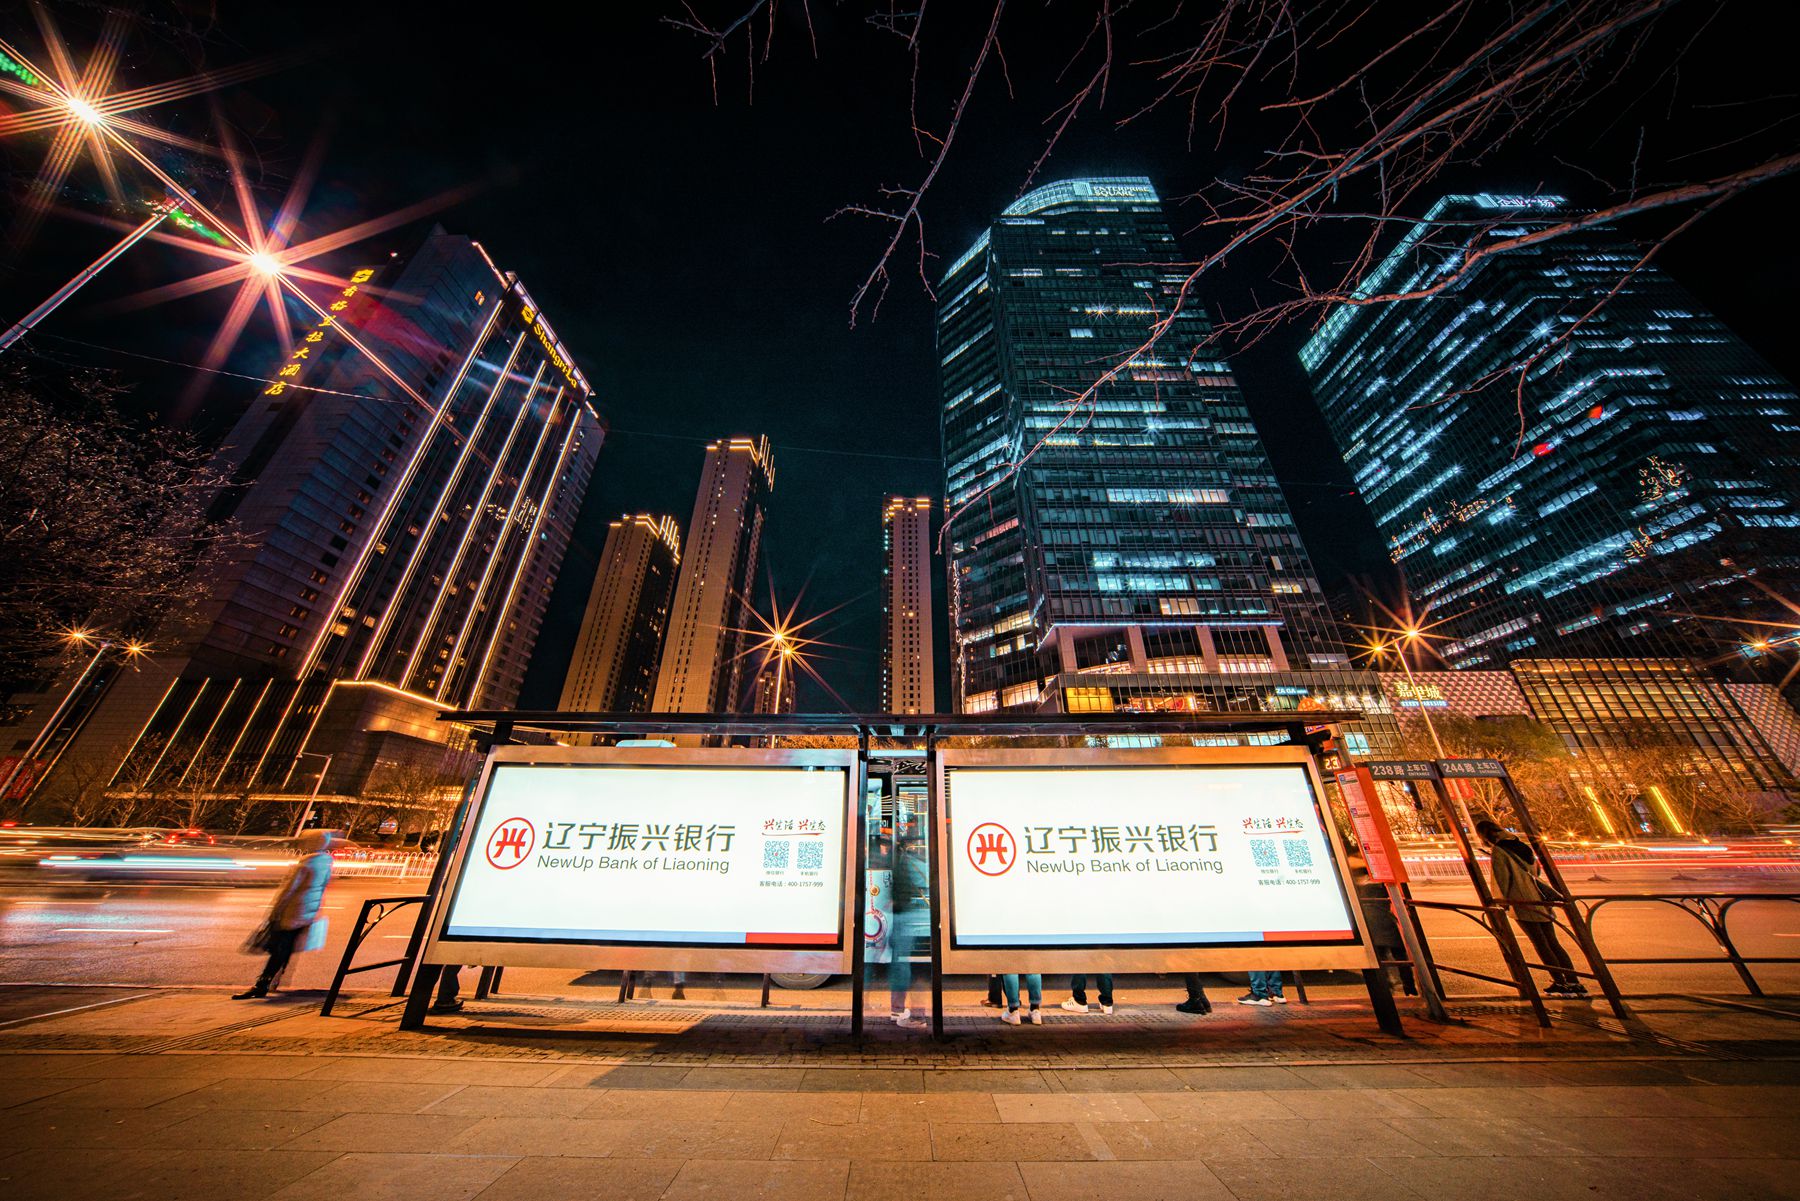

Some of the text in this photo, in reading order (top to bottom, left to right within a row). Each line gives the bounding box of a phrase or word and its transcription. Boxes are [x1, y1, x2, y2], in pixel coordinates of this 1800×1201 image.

[542, 822, 735, 852] 辽宁振兴银行
[1024, 824, 1218, 854] 辽宁振兴银行
[537, 855, 729, 874] NewUp Bank of Liaoning
[1026, 858, 1224, 875] NewUp Bank of Liaoning
